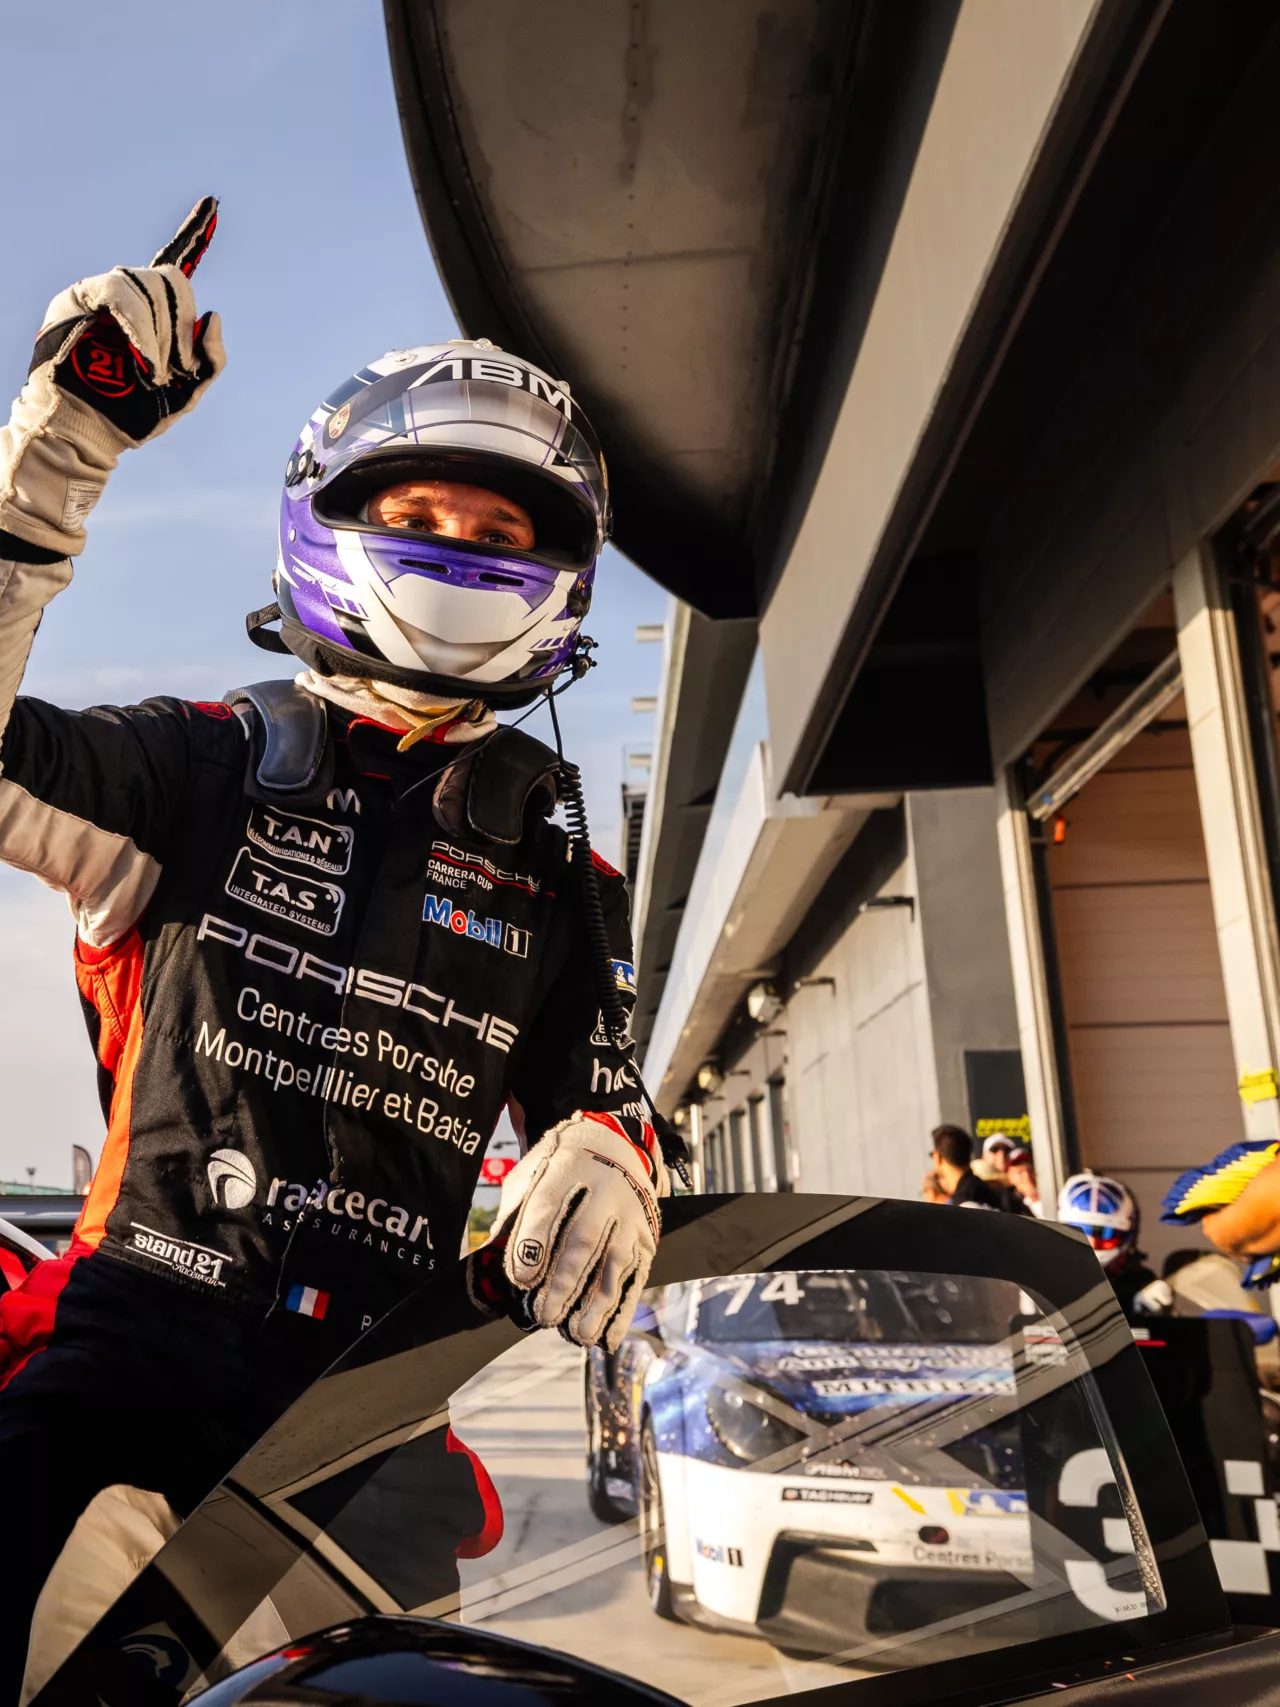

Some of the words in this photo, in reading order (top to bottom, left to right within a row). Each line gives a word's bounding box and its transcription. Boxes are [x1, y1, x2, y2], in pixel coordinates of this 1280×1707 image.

[88, 350, 123, 379] 21
[407, 359, 571, 420] ABM
[263, 814, 331, 854] T.A.N
[251, 870, 317, 911] T.A.S
[426, 870, 467, 889] FRANCE
[427, 859, 476, 882] CARRERA
[477, 875, 493, 891] CUP
[230, 884, 287, 914] INTEGRATED
[289, 910, 331, 932] SYSTEMS
[422, 893, 502, 949] Mobil
[383, 1092, 413, 1124] et
[262, 1212, 435, 1270] ASSURANCES
[716, 1272, 805, 1316] 74
